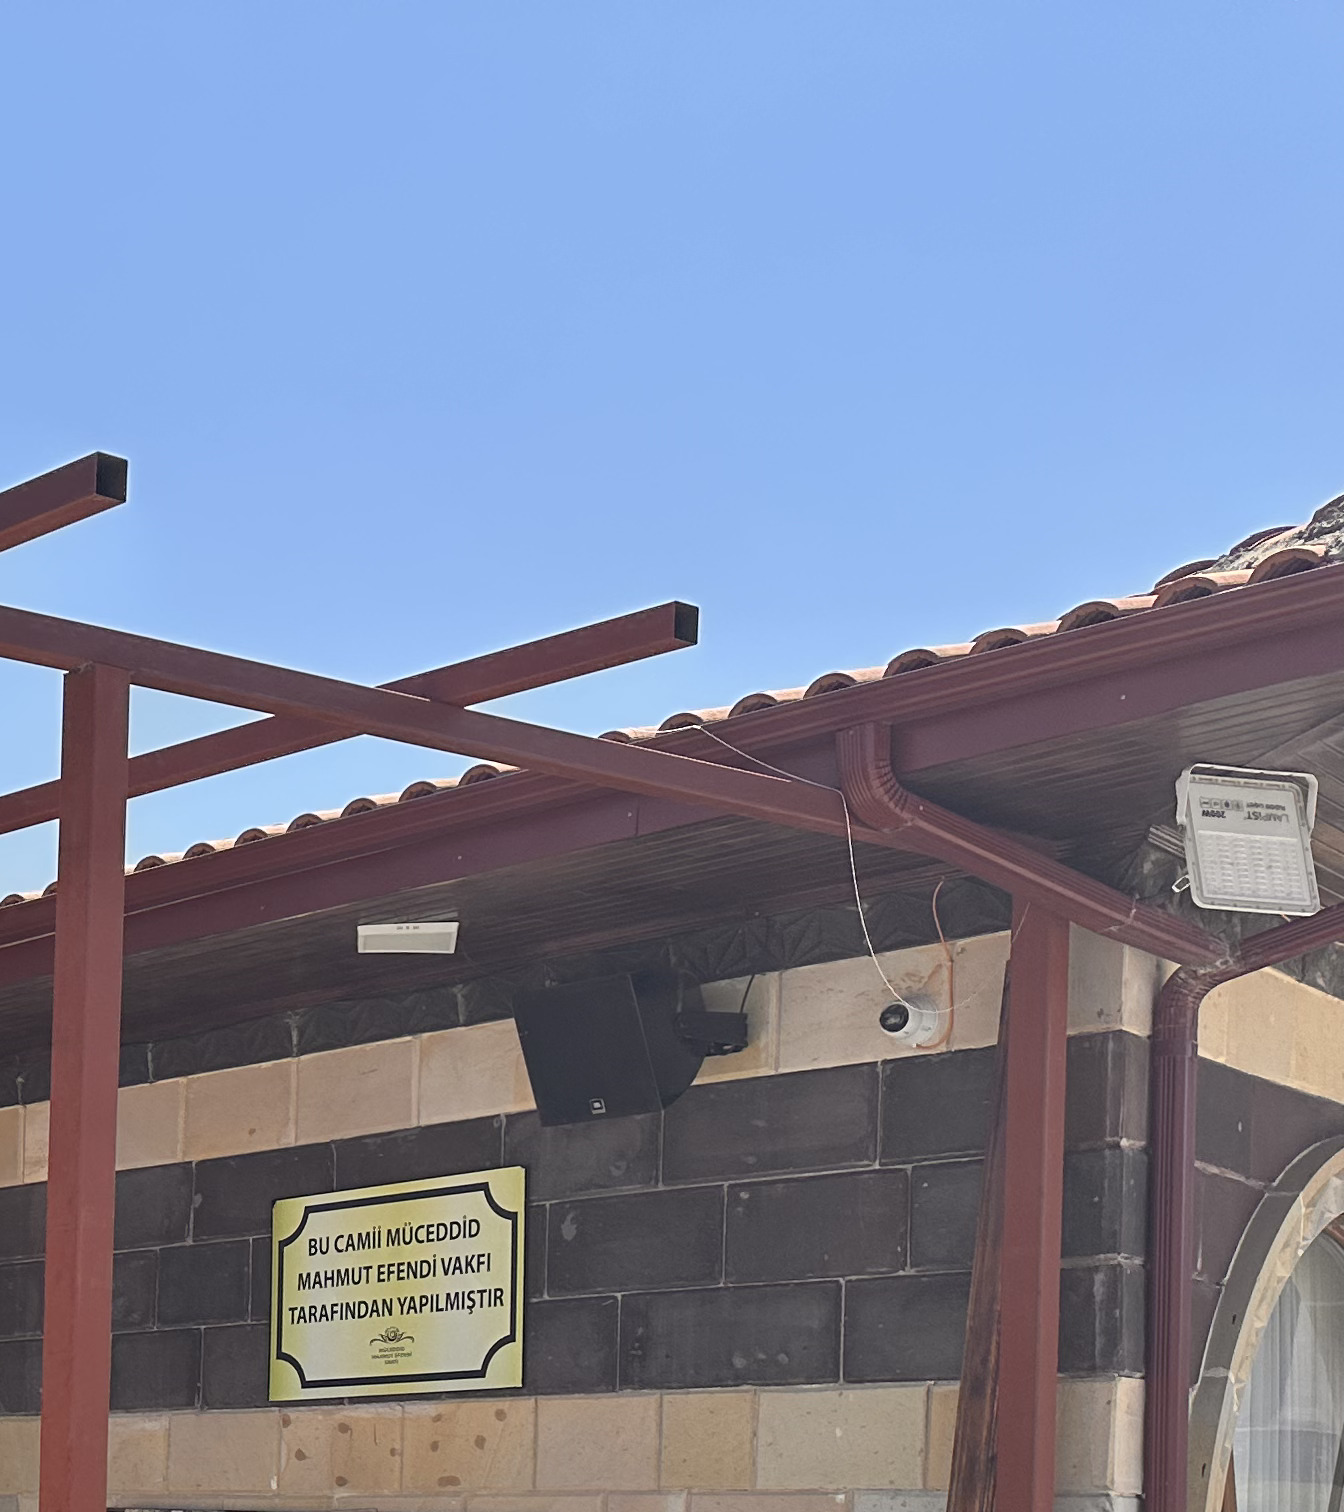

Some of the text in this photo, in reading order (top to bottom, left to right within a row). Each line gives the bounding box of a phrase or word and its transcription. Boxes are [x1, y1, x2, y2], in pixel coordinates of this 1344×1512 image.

[308, 1214, 481, 1257] BU CAMİİ MÜCEDDİD
[297, 1252, 492, 1291] MAHMUT EFENDİ VAKFI
[288, 1287, 505, 1325] TARAFINDAN YAPILMIŞTIR
